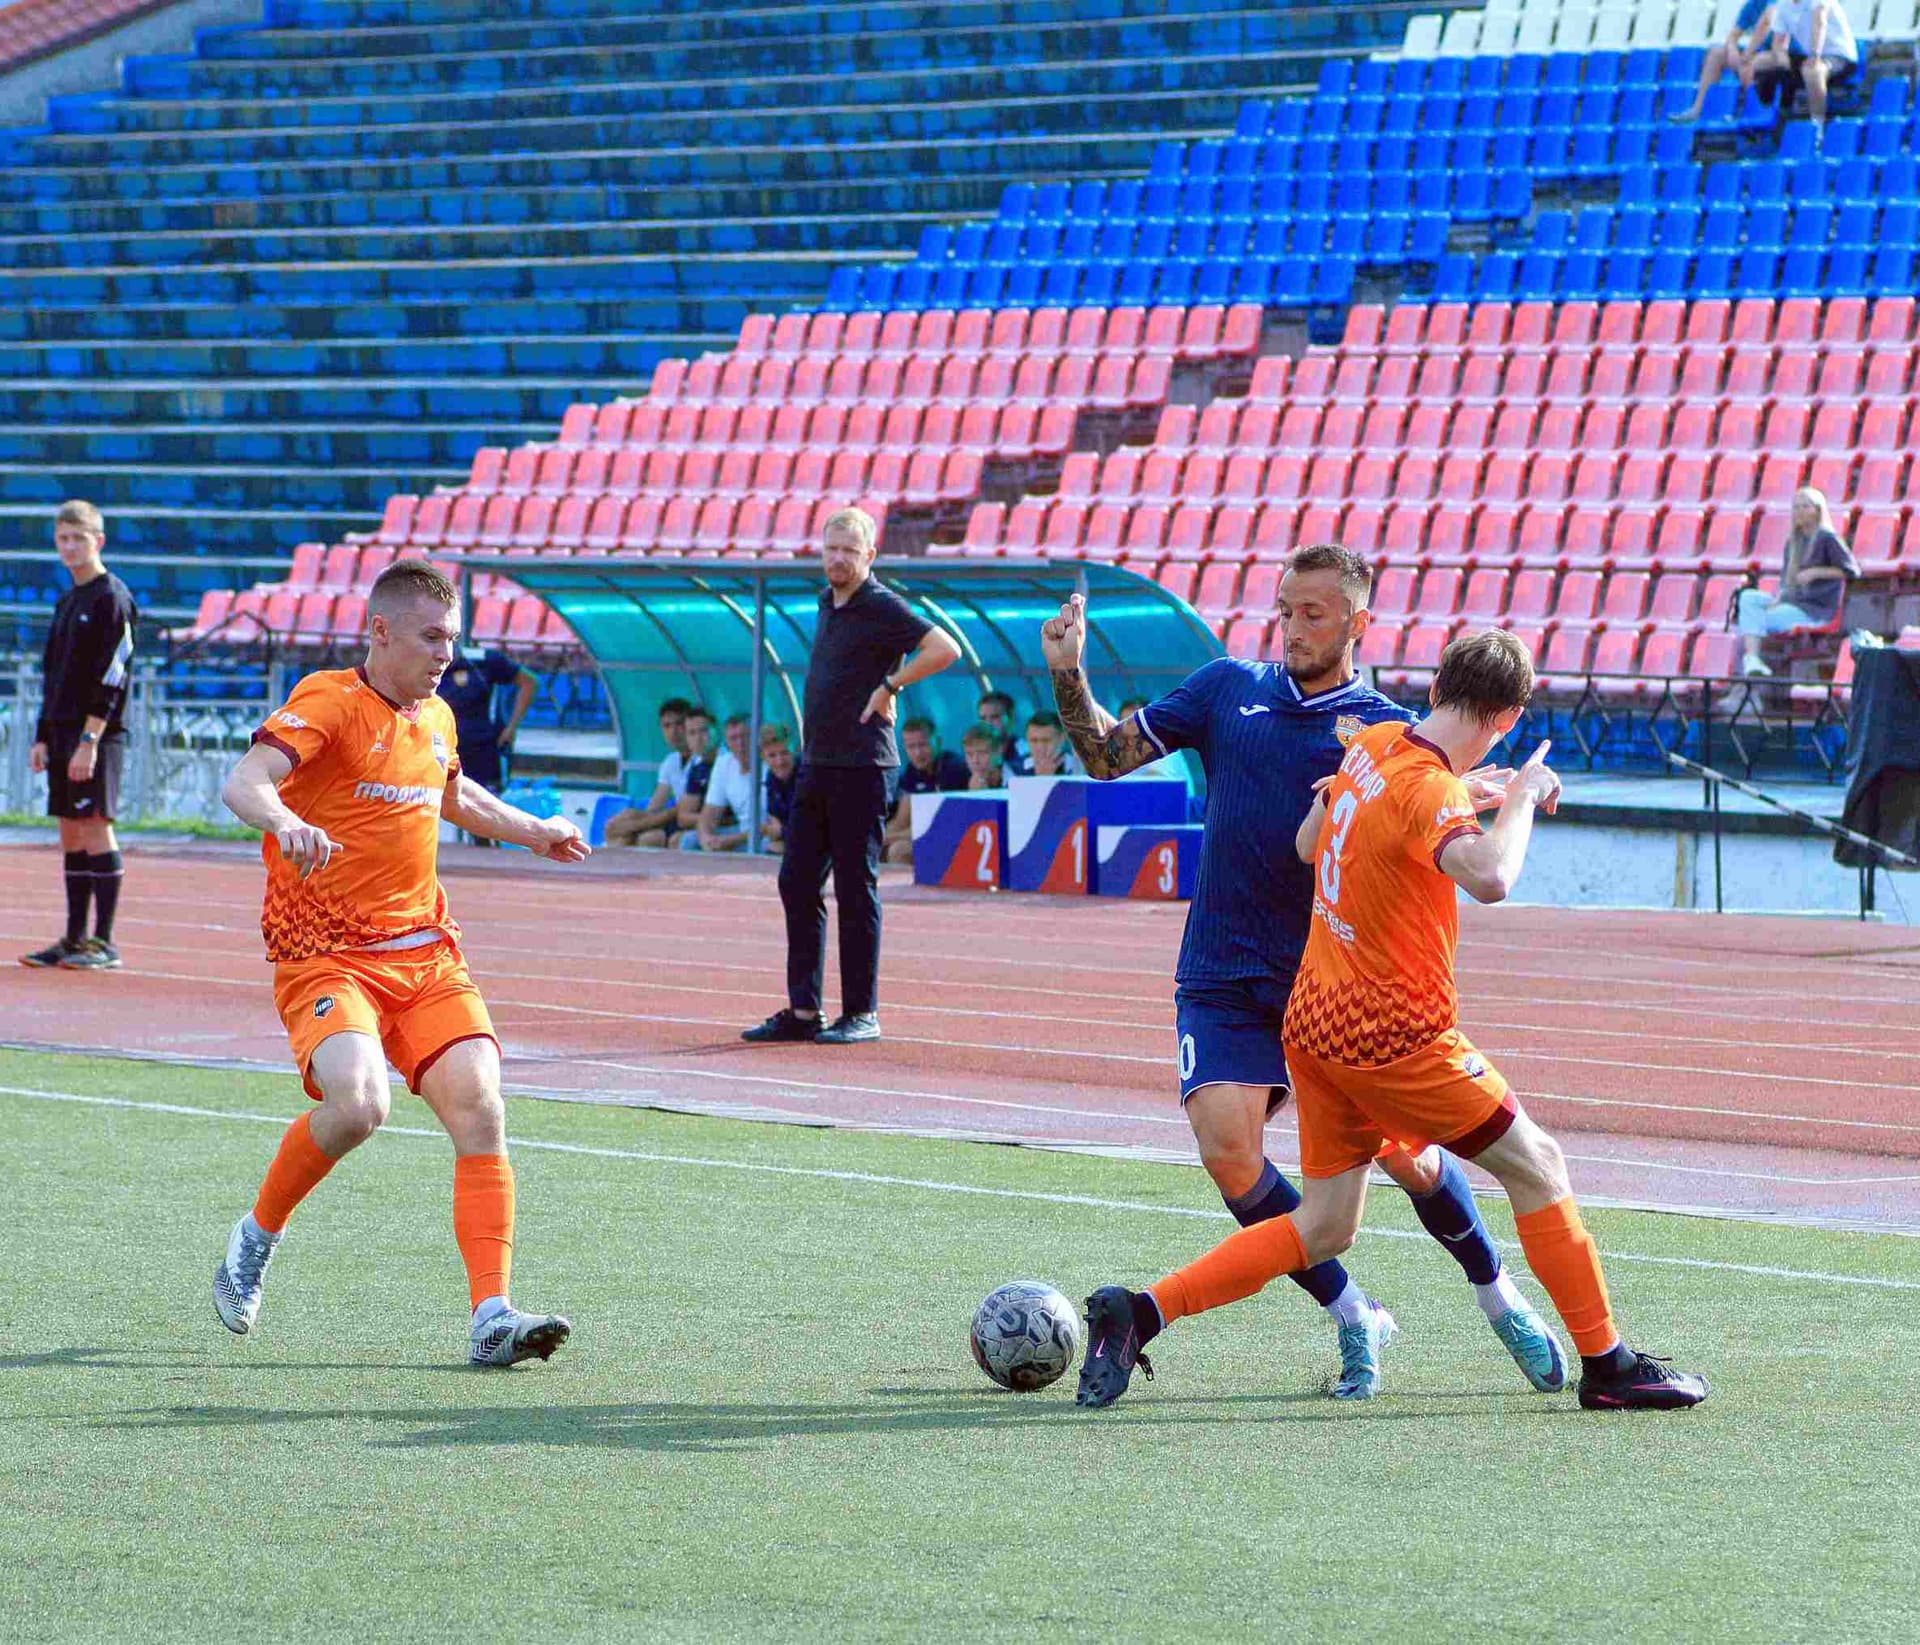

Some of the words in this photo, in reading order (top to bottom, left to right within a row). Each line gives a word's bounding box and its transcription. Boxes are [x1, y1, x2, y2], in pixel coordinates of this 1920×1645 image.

[976, 825, 993, 882] 2
[1071, 826, 1083, 883] 1
[1158, 847, 1174, 894] 3
[1320, 789, 1358, 905] 3
